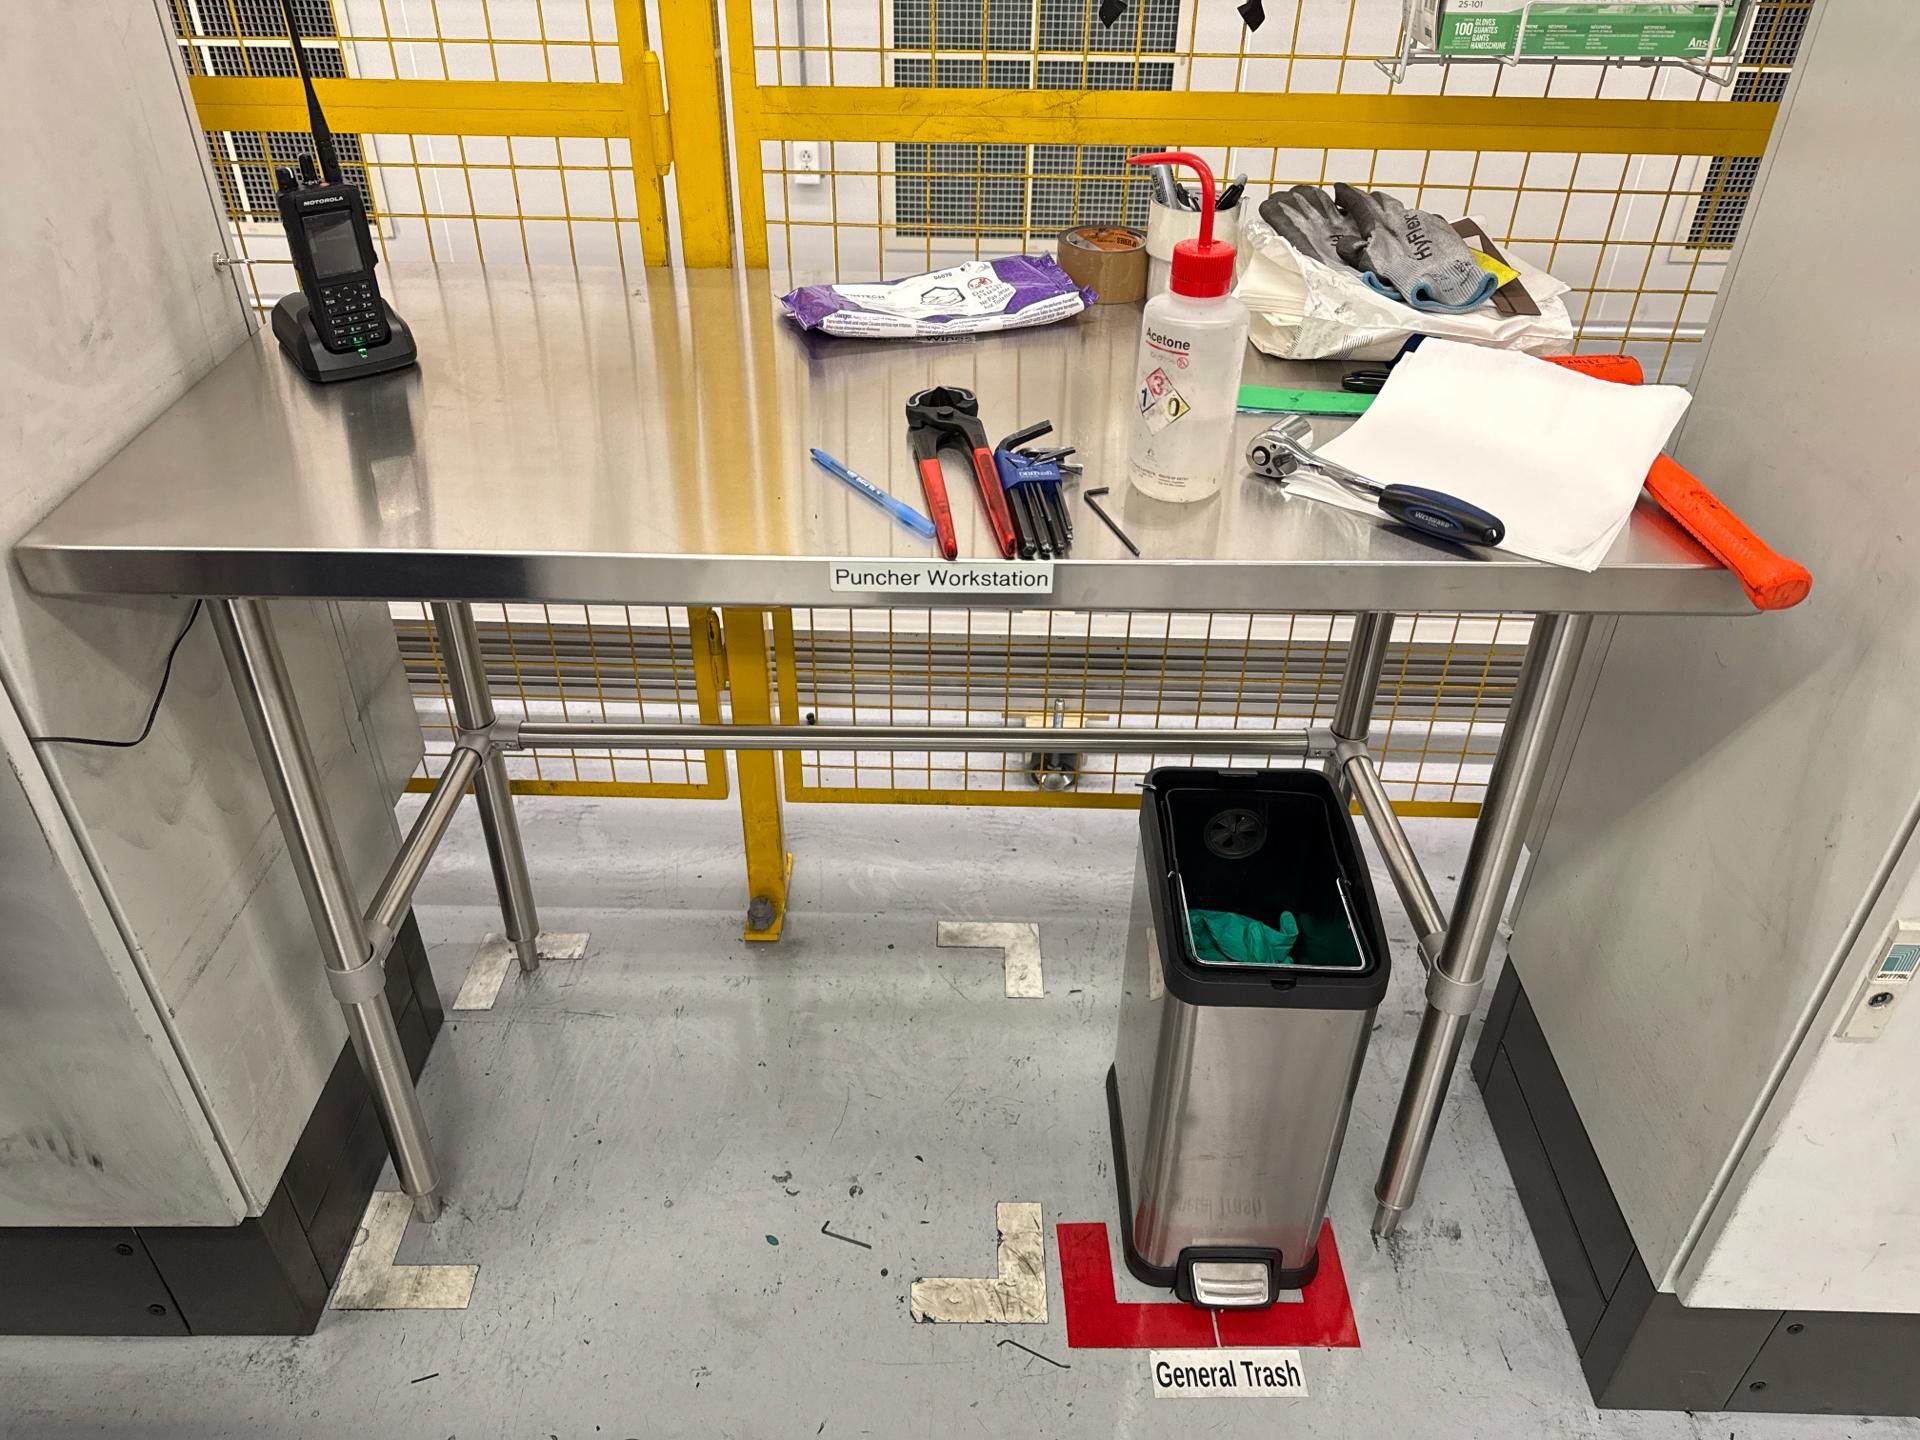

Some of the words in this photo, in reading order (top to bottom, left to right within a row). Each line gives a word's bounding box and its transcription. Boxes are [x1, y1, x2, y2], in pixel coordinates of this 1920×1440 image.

[1458, 0, 1483, 8] 25-101
[1455, 22, 1474, 36] 100
[1473, 26, 1498, 34] GUANTES
[1475, 18, 1497, 26] GLOVES
[1688, 37, 1721, 48] Ansl
[303, 195, 344, 206] MOTOROLA
[1404, 214, 1433, 261] HyFlex
[1146, 327, 1191, 351] Acetone
[1152, 375, 1165, 396] 3
[1141, 387, 1148, 407] 1
[1168, 397, 1180, 417] 0
[835, 569, 921, 586] Puncher
[928, 569, 1049, 587] Workstation
[1156, 1359, 1237, 1388] General
[1240, 1359, 1301, 1387] Trash
